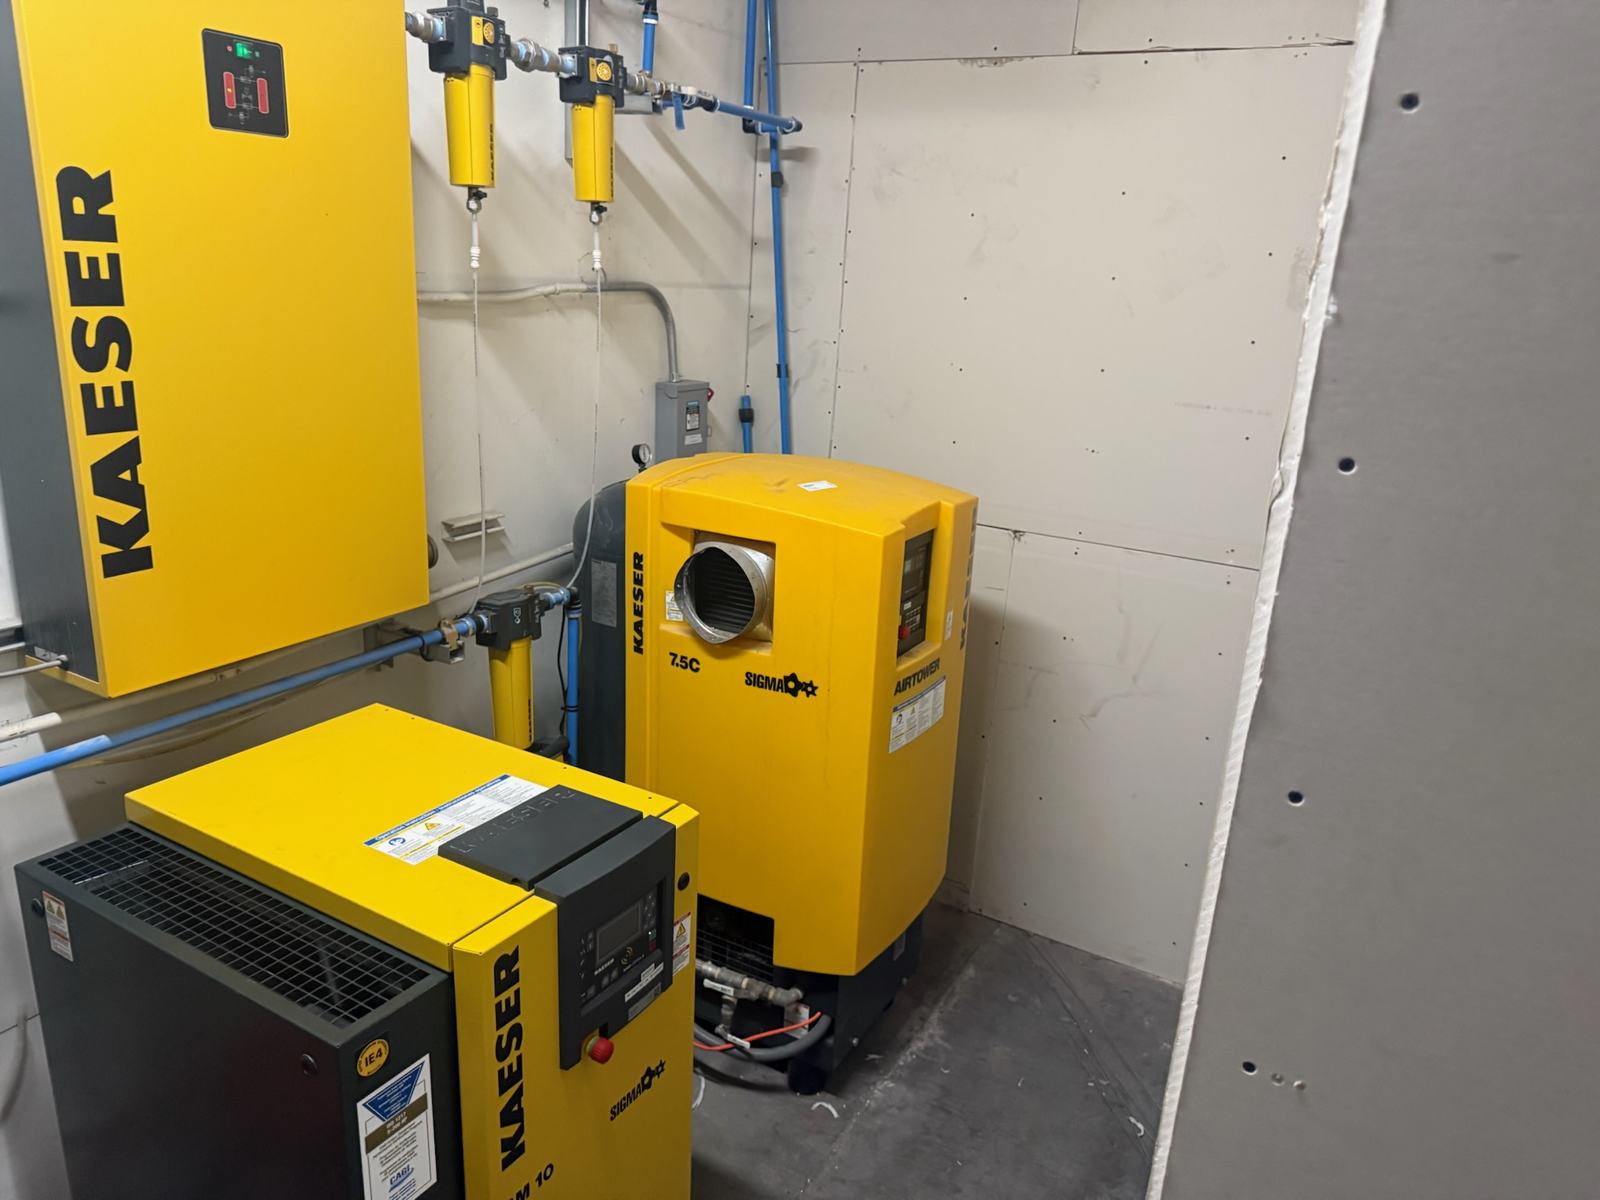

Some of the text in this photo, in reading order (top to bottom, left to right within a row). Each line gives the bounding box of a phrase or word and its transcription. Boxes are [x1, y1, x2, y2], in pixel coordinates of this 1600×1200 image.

[56, 166, 153, 579] KAESER
[633, 552, 644, 656] KAESER
[669, 652, 700, 673] 7.5C
[894, 658, 941, 696] AIRTOWER
[745, 671, 785, 694] SIGMA
[364, 1047, 383, 1067] IE4
[494, 945, 526, 1172] KAESER
[610, 1084, 643, 1121] SIGMA
[535, 1163, 554, 1187] 10
